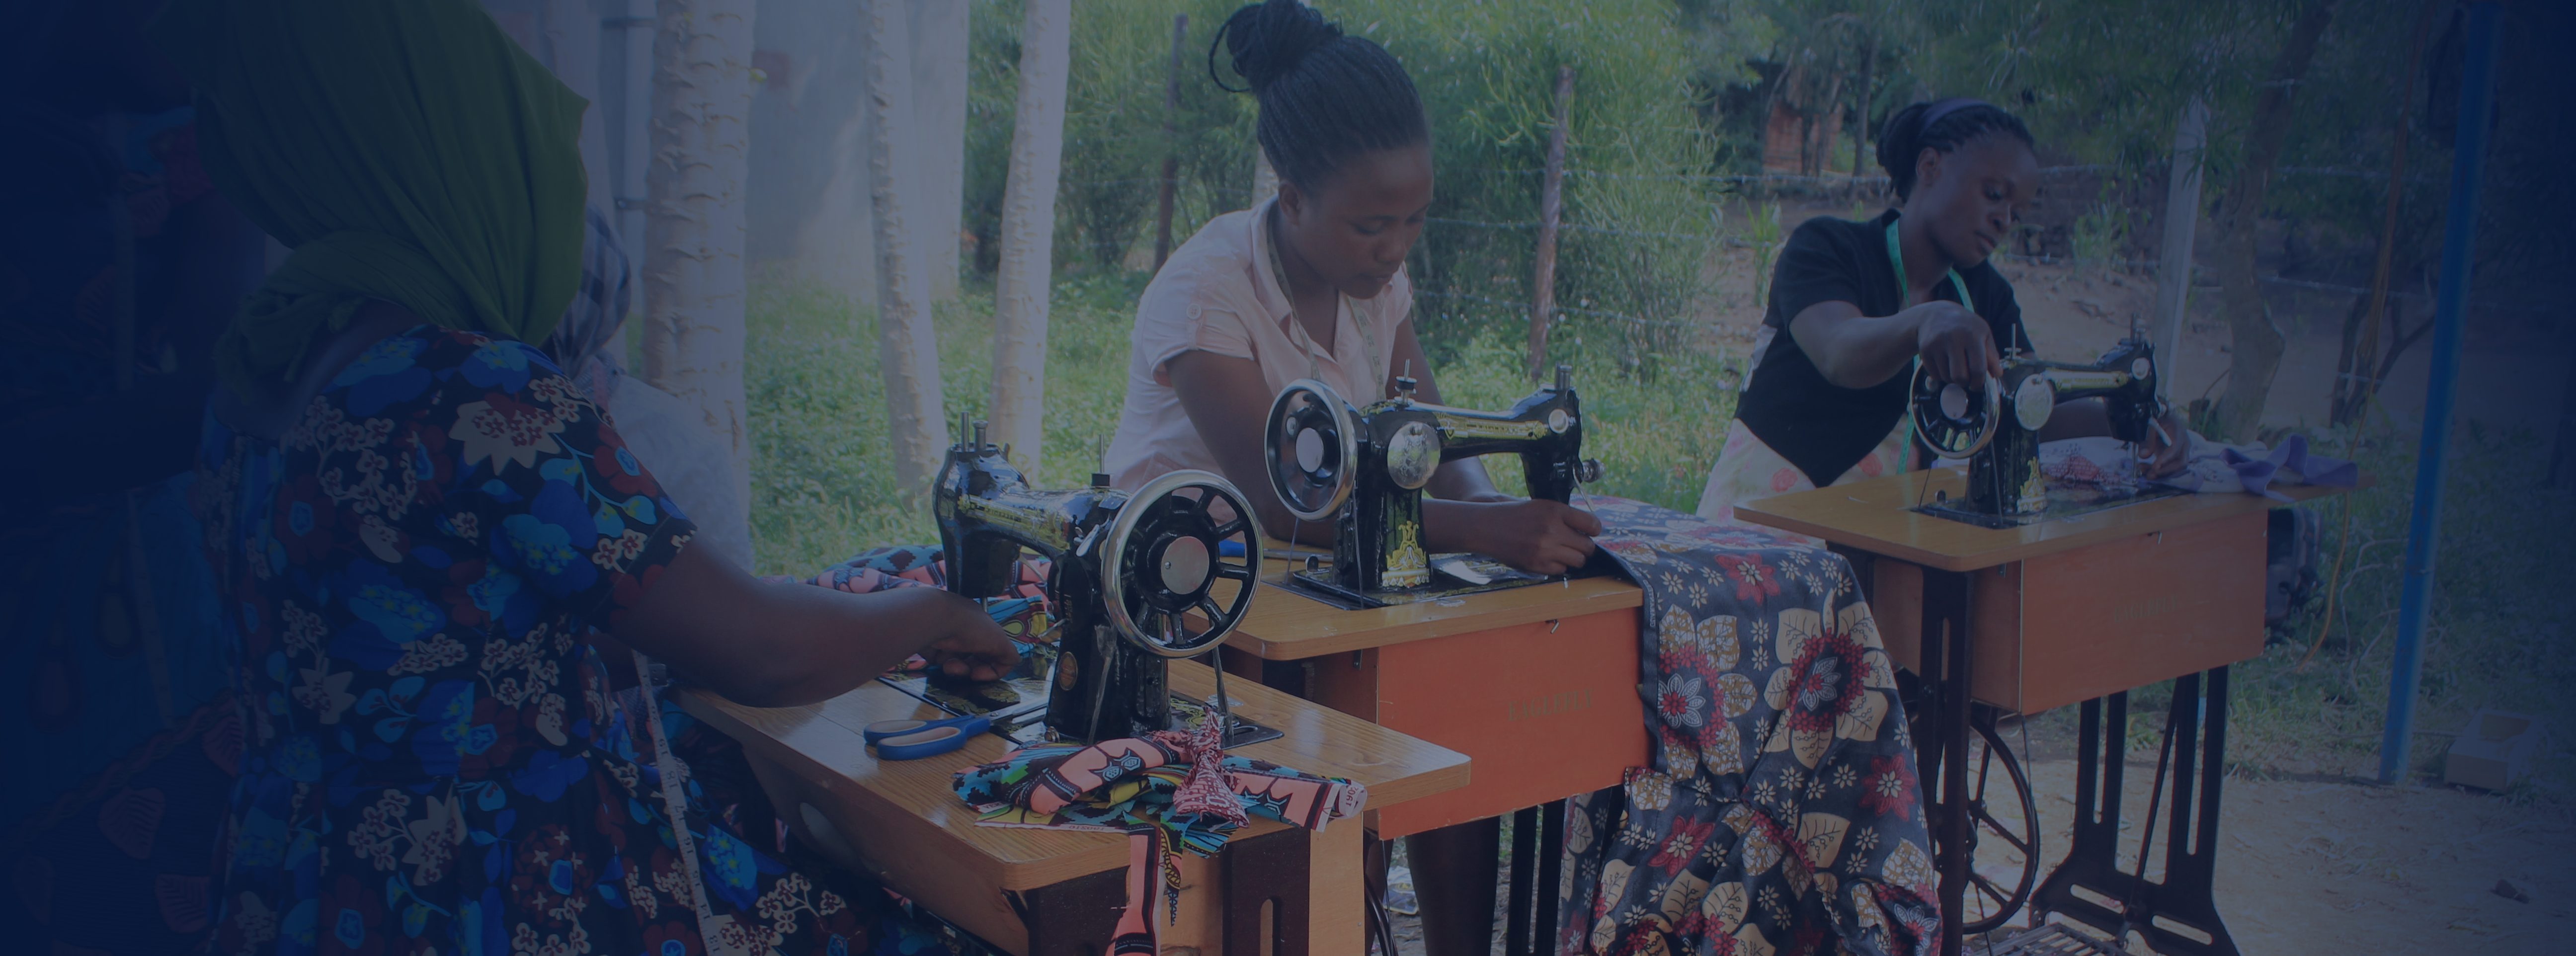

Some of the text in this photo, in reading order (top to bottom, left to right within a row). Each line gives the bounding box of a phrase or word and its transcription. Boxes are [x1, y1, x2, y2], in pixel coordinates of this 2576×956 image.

[1507, 688, 1594, 722] EAGLEFLY
[658, 738, 668, 756] 19
[666, 771, 678, 790] 18
[675, 804, 685, 822] 17
[683, 837, 694, 854] 16
[692, 870, 701, 887] 15
[700, 903, 711, 920] 14
[709, 935, 720, 954] 13
